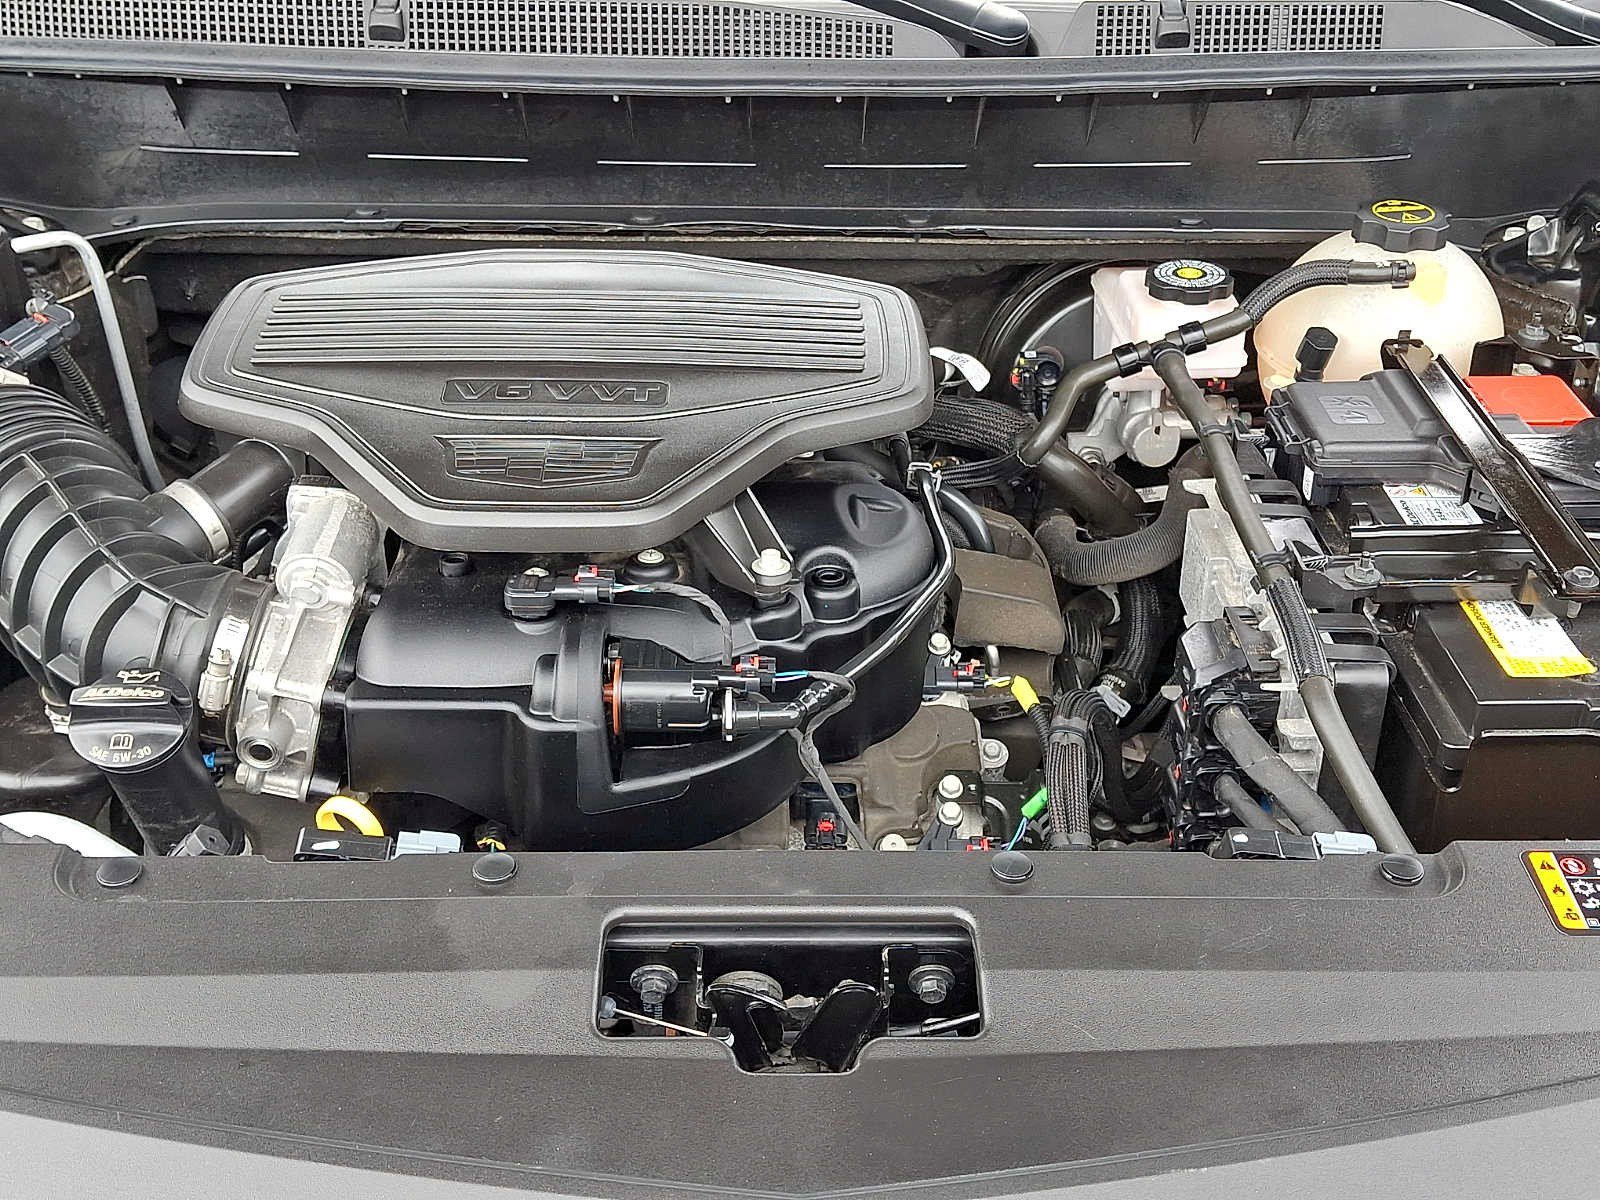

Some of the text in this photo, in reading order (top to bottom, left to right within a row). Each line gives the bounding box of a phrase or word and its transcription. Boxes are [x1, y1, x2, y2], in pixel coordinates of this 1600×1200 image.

[454, 382, 661, 402] V6 VVT
[81, 687, 165, 698] ACDelco
[89, 745, 152, 763] SAE 5W-30
